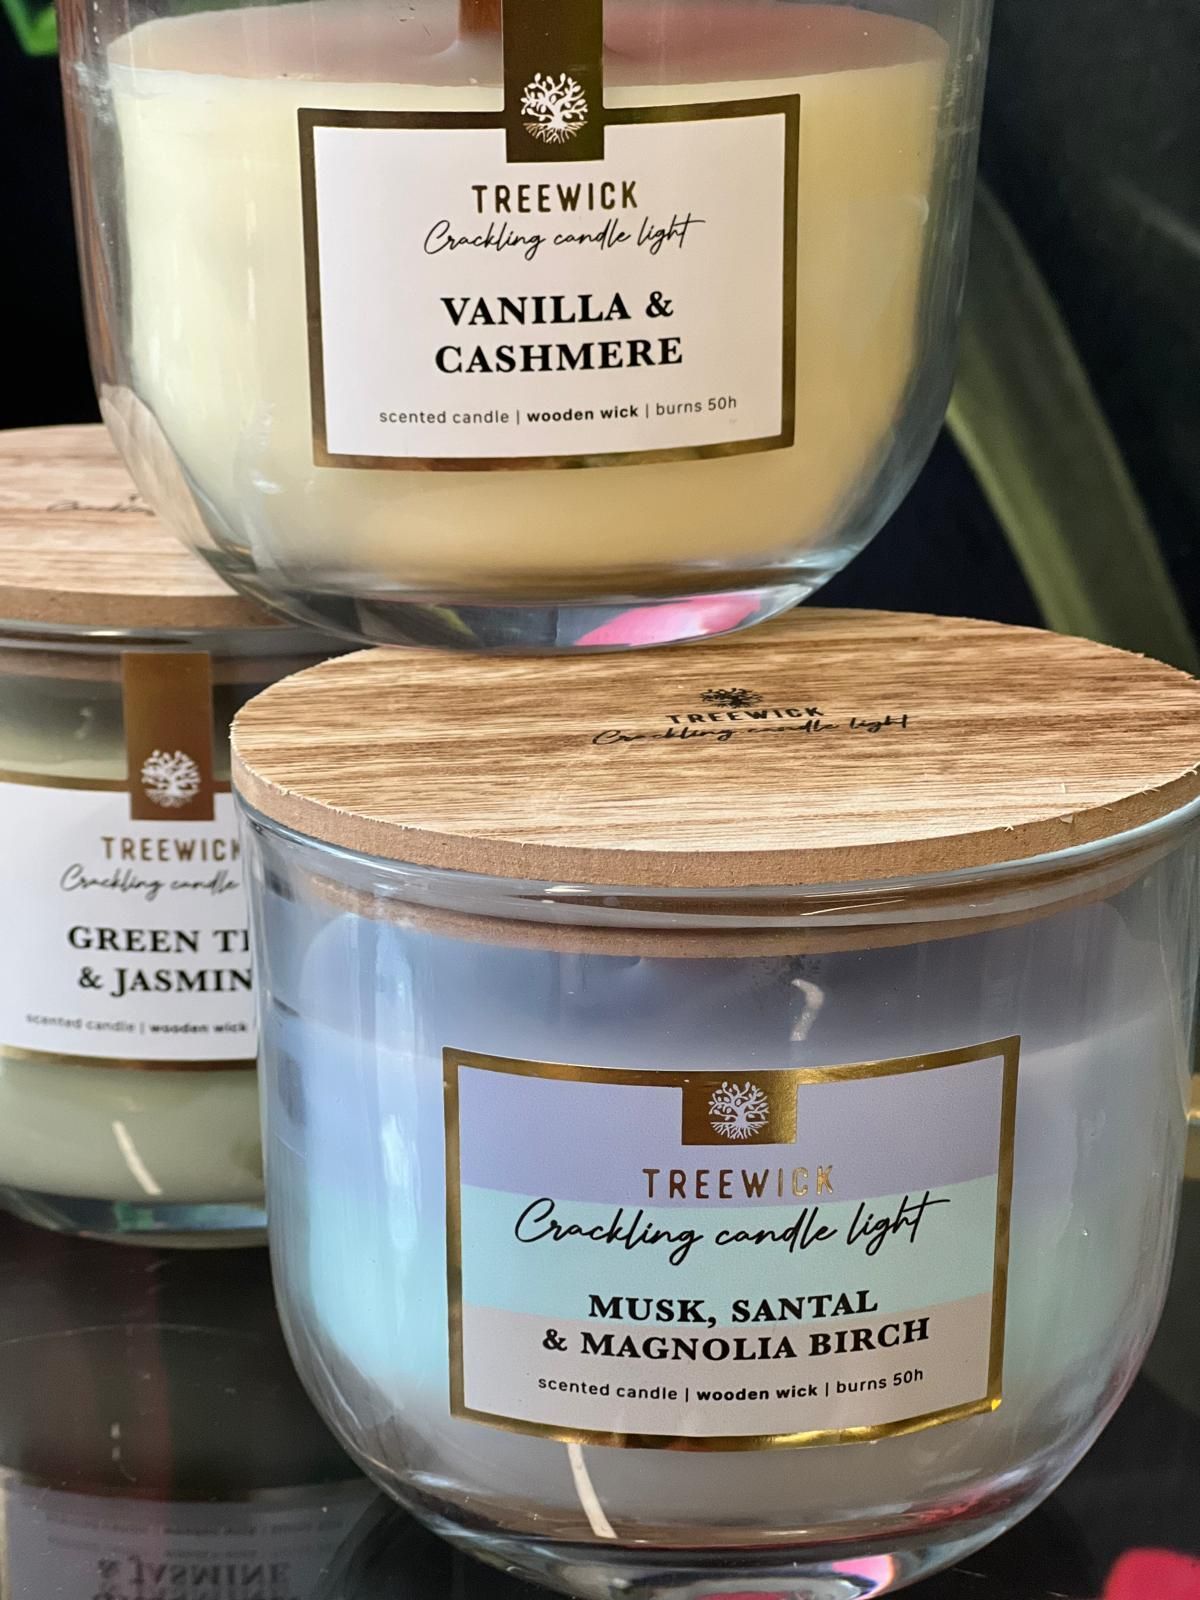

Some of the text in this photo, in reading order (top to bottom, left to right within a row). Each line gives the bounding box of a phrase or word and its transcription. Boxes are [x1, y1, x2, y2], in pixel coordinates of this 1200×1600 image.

[471, 181, 638, 214] TREEWICK
[423, 213, 706, 261] Crackling candle light
[440, 291, 674, 326] VANILLA &
[434, 337, 683, 374] CASHMERE
[379, 395, 737, 424] scented candle wooden wick burns 50h
[666, 706, 825, 725] TREEWICK
[849, 714, 909, 733] light
[60, 863, 240, 902] Crackling candle
[67, 926, 199, 954] GREEN
[78, 966, 104, 990] &
[26, 1013, 248, 1035] scented candle wooden wick
[643, 1165, 834, 1199] TREEWICK
[515, 1191, 951, 1266] Crackling candle light
[588, 1289, 879, 1329] MUSK, SANTAL
[542, 1317, 930, 1361] & MAGNOLIA BIRCH
[538, 1368, 924, 1402] scented candle wooden wick burns 50h
